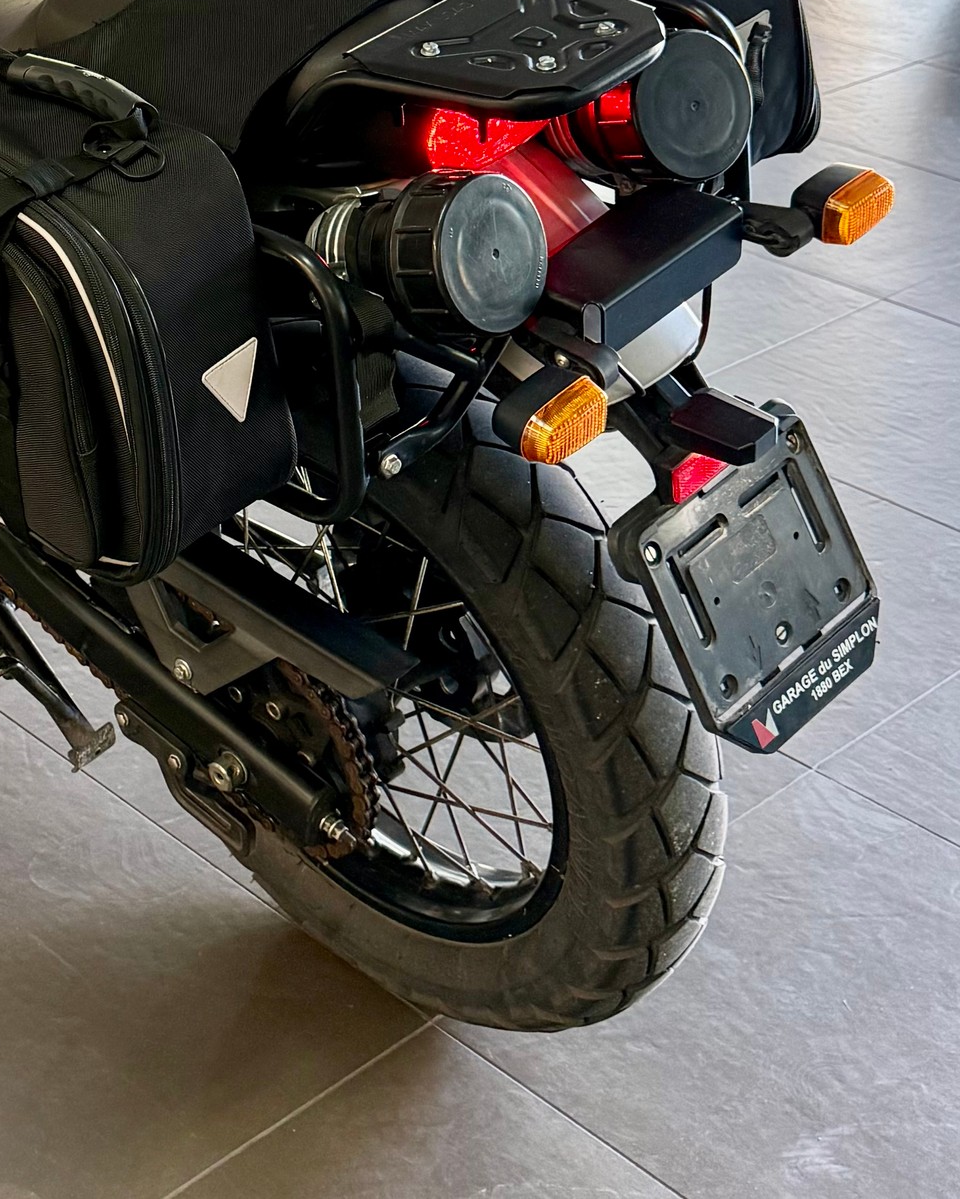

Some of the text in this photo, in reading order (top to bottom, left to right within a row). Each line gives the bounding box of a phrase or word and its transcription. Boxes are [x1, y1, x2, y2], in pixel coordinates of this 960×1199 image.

[772, 616, 878, 714] GARAGE du SIMPLON
[810, 659, 854, 701] 1880 BEX
